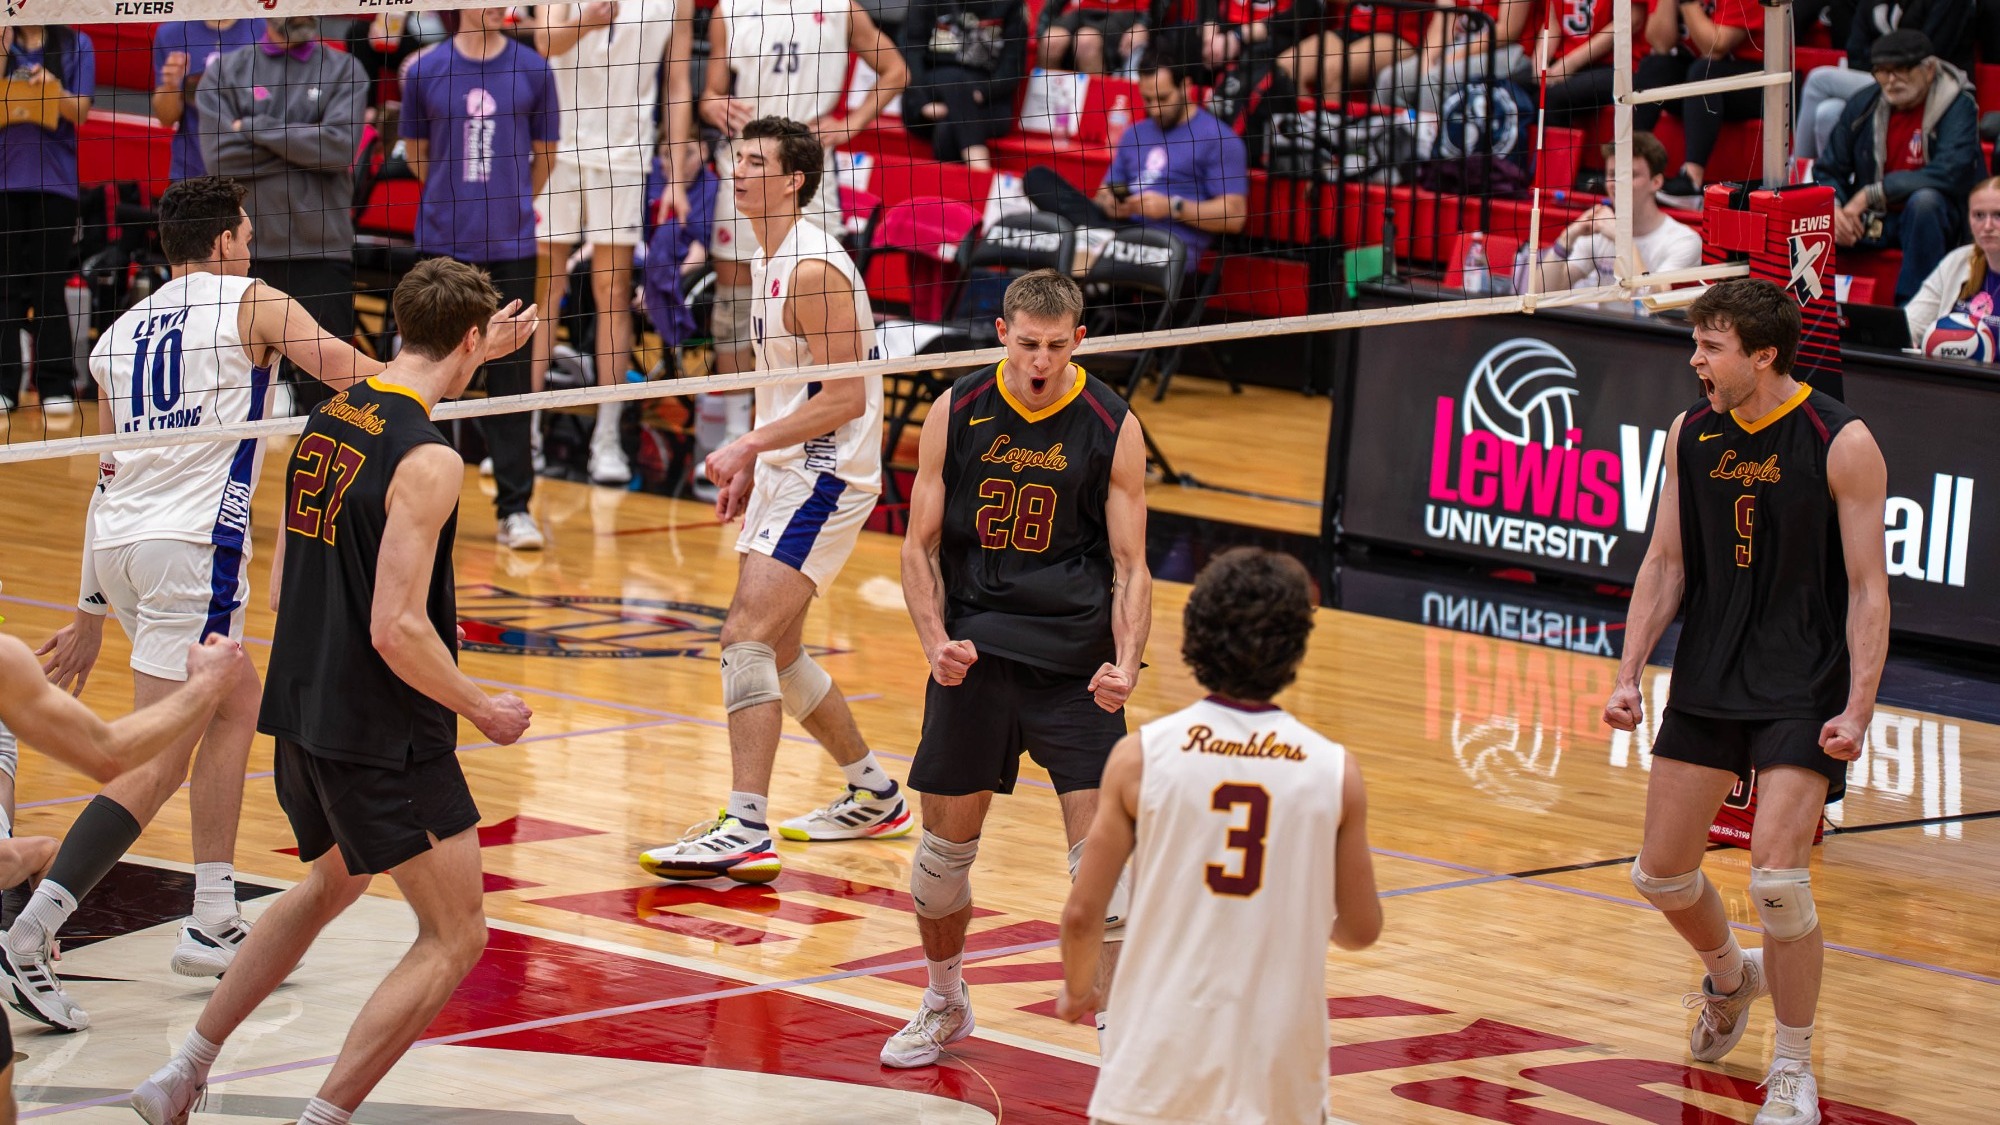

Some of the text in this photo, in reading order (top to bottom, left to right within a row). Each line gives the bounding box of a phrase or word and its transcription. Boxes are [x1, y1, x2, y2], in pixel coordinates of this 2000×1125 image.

[115, 2, 174, 15] FLYERS
[771, 42, 799, 73] 23
[1791, 215, 1831, 233] LEWIS
[132, 328, 183, 418] 10
[981, 434, 1068, 473] Loyola
[218, 476, 250, 533] FLYERS
[287, 432, 366, 546] 27
[976, 477, 1058, 553] 28
[1425, 503, 1619, 567] UNIVERSITY
[1182, 725, 1308, 762] Ramblers
[1204, 780, 1272, 899] 3
[1721, 827, 1751, 840] 556-3198
